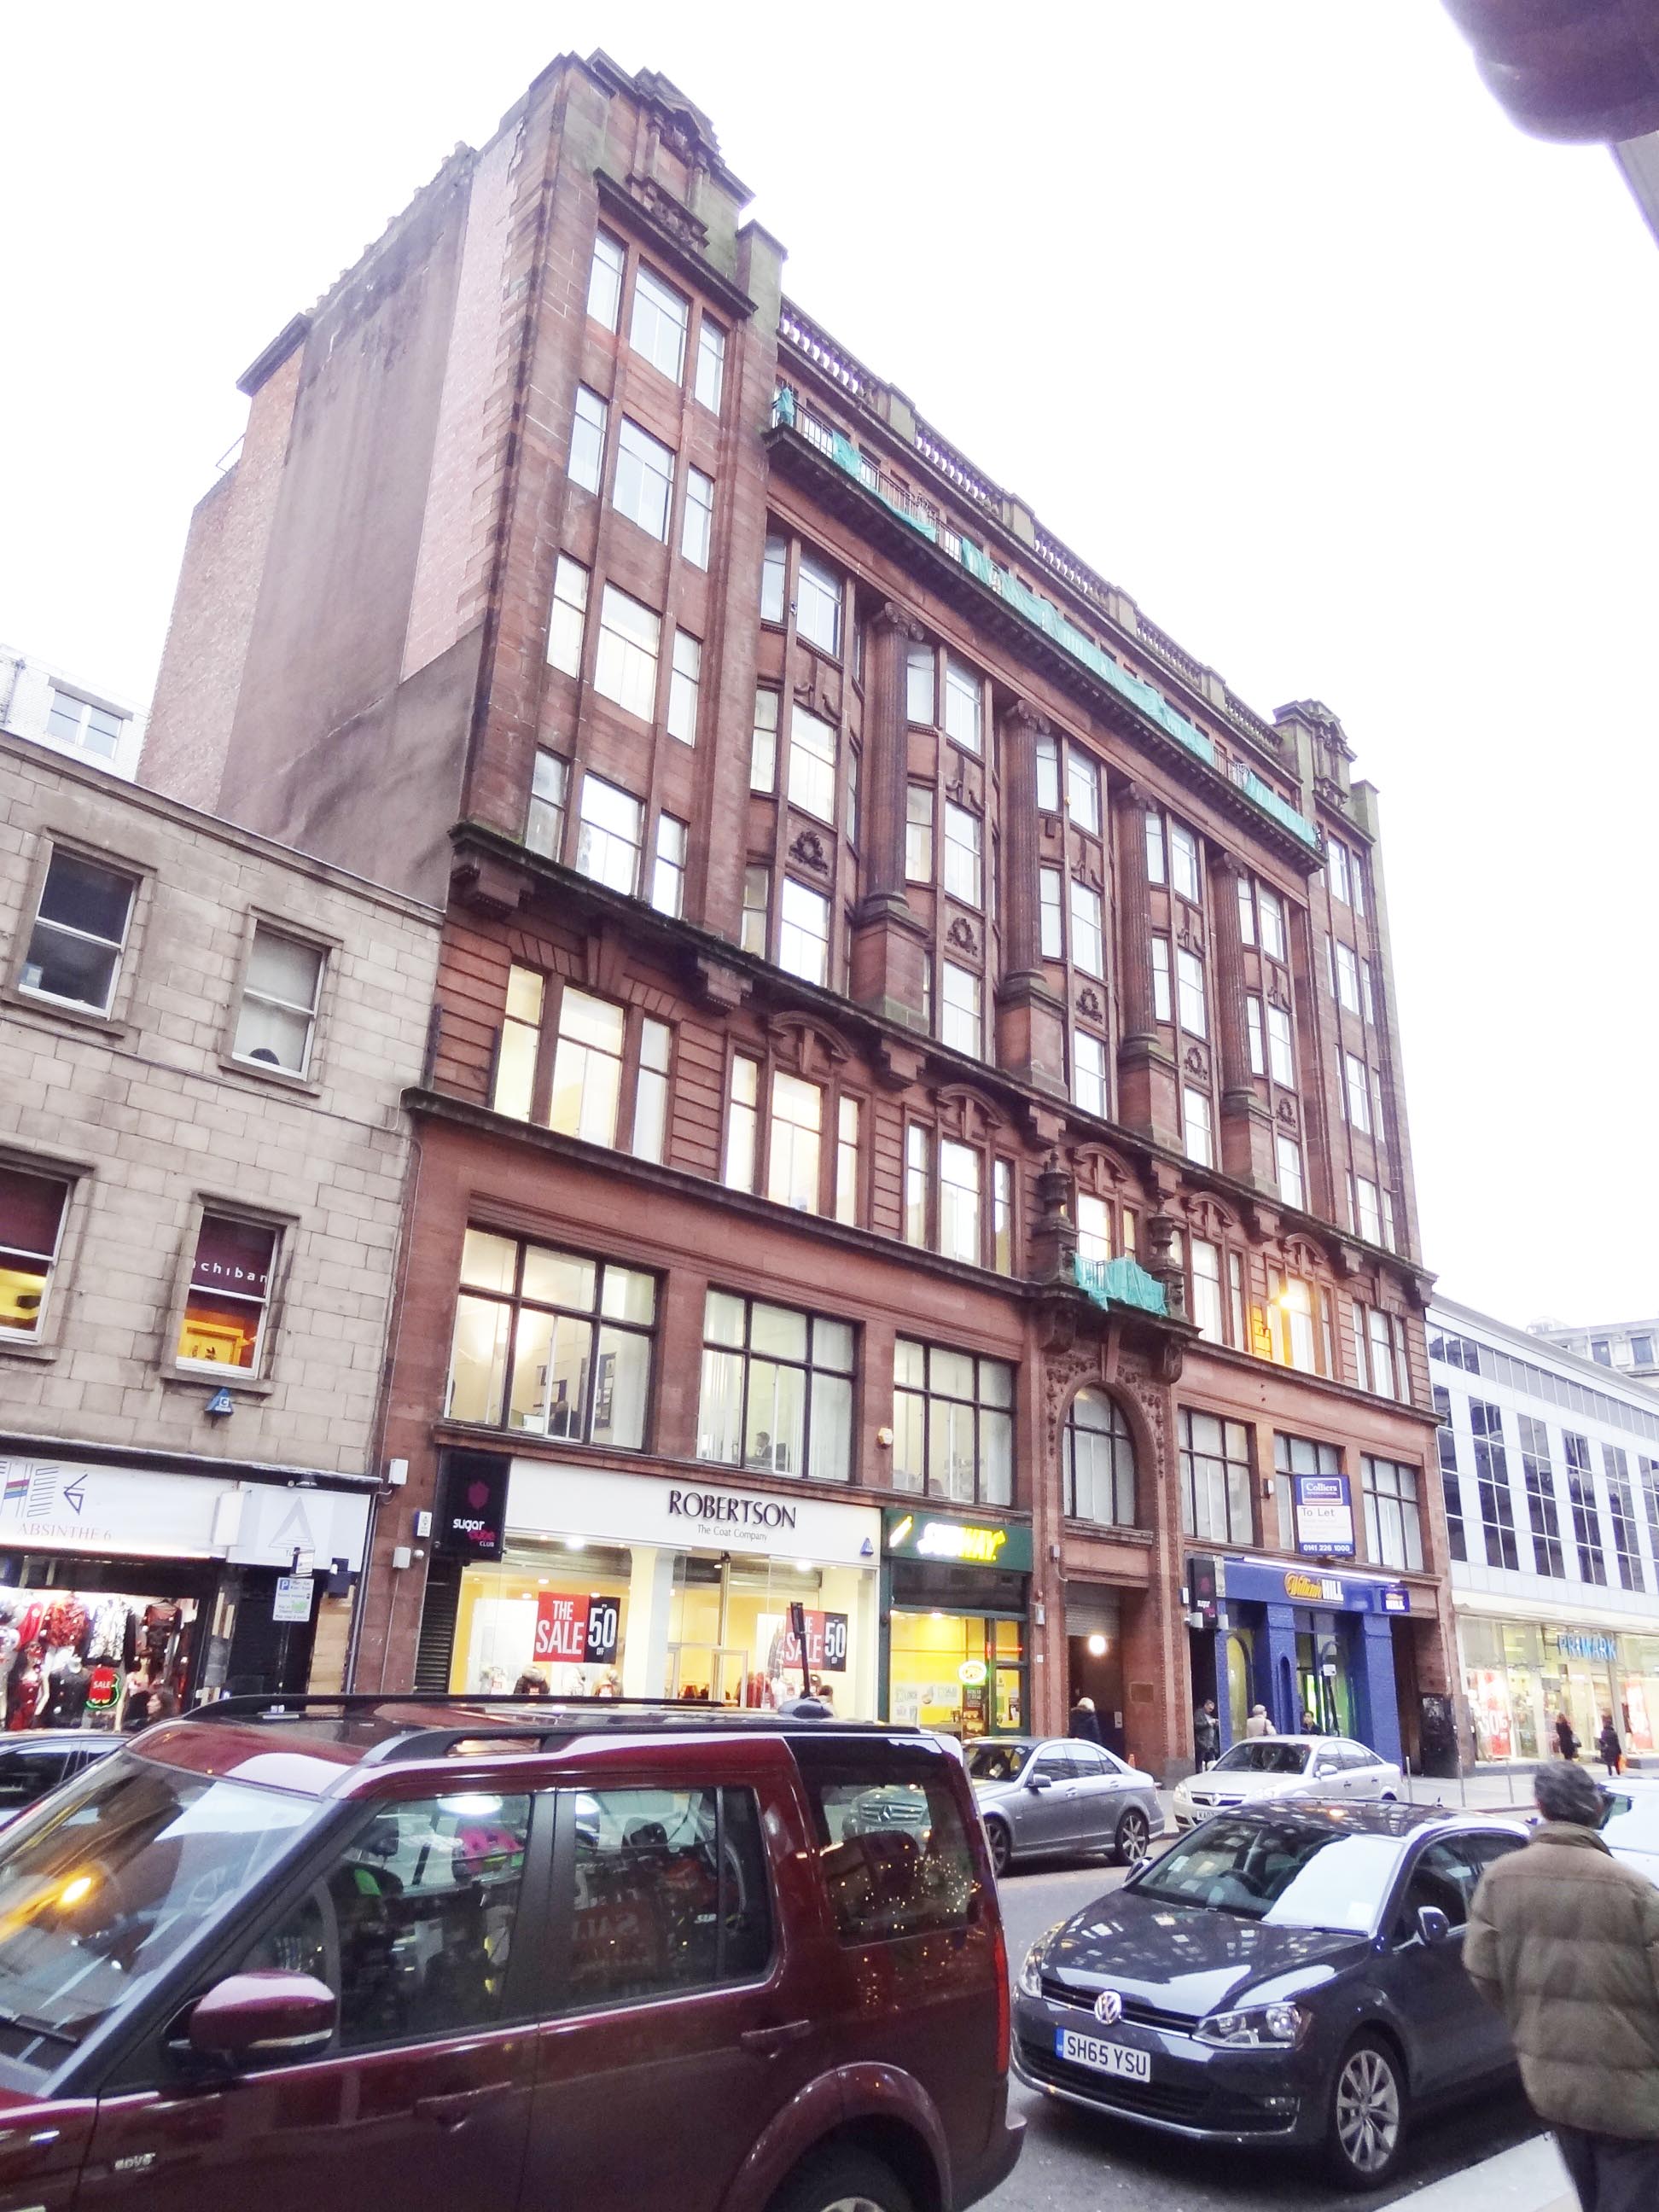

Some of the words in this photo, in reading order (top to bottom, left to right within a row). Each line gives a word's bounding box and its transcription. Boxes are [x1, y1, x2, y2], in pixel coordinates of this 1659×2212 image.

[1306, 1482, 1338, 1492] Colliers
[669, 1490, 796, 1529] ROBERTSON
[1301, 1508, 1313, 1516] To
[19, 1522, 96, 1540] ABSINTHE
[452, 1518, 485, 1532] sugar
[697, 1524, 711, 1534] The
[713, 1526, 731, 1537] Coat
[734, 1528, 767, 1542] Company
[1321, 1579, 1344, 1602] HILL
[553, 1600, 573, 1621] THE
[536, 1620, 585, 1655] SALE
[588, 1608, 617, 1648] 50
[824, 1622, 847, 1657] 50
[1557, 1633, 1618, 1660] PRIMARK
[93, 1680, 111, 1689] SALE
[1068, 2036, 1109, 2065] SH65
[1114, 2048, 1146, 2076] YSU
